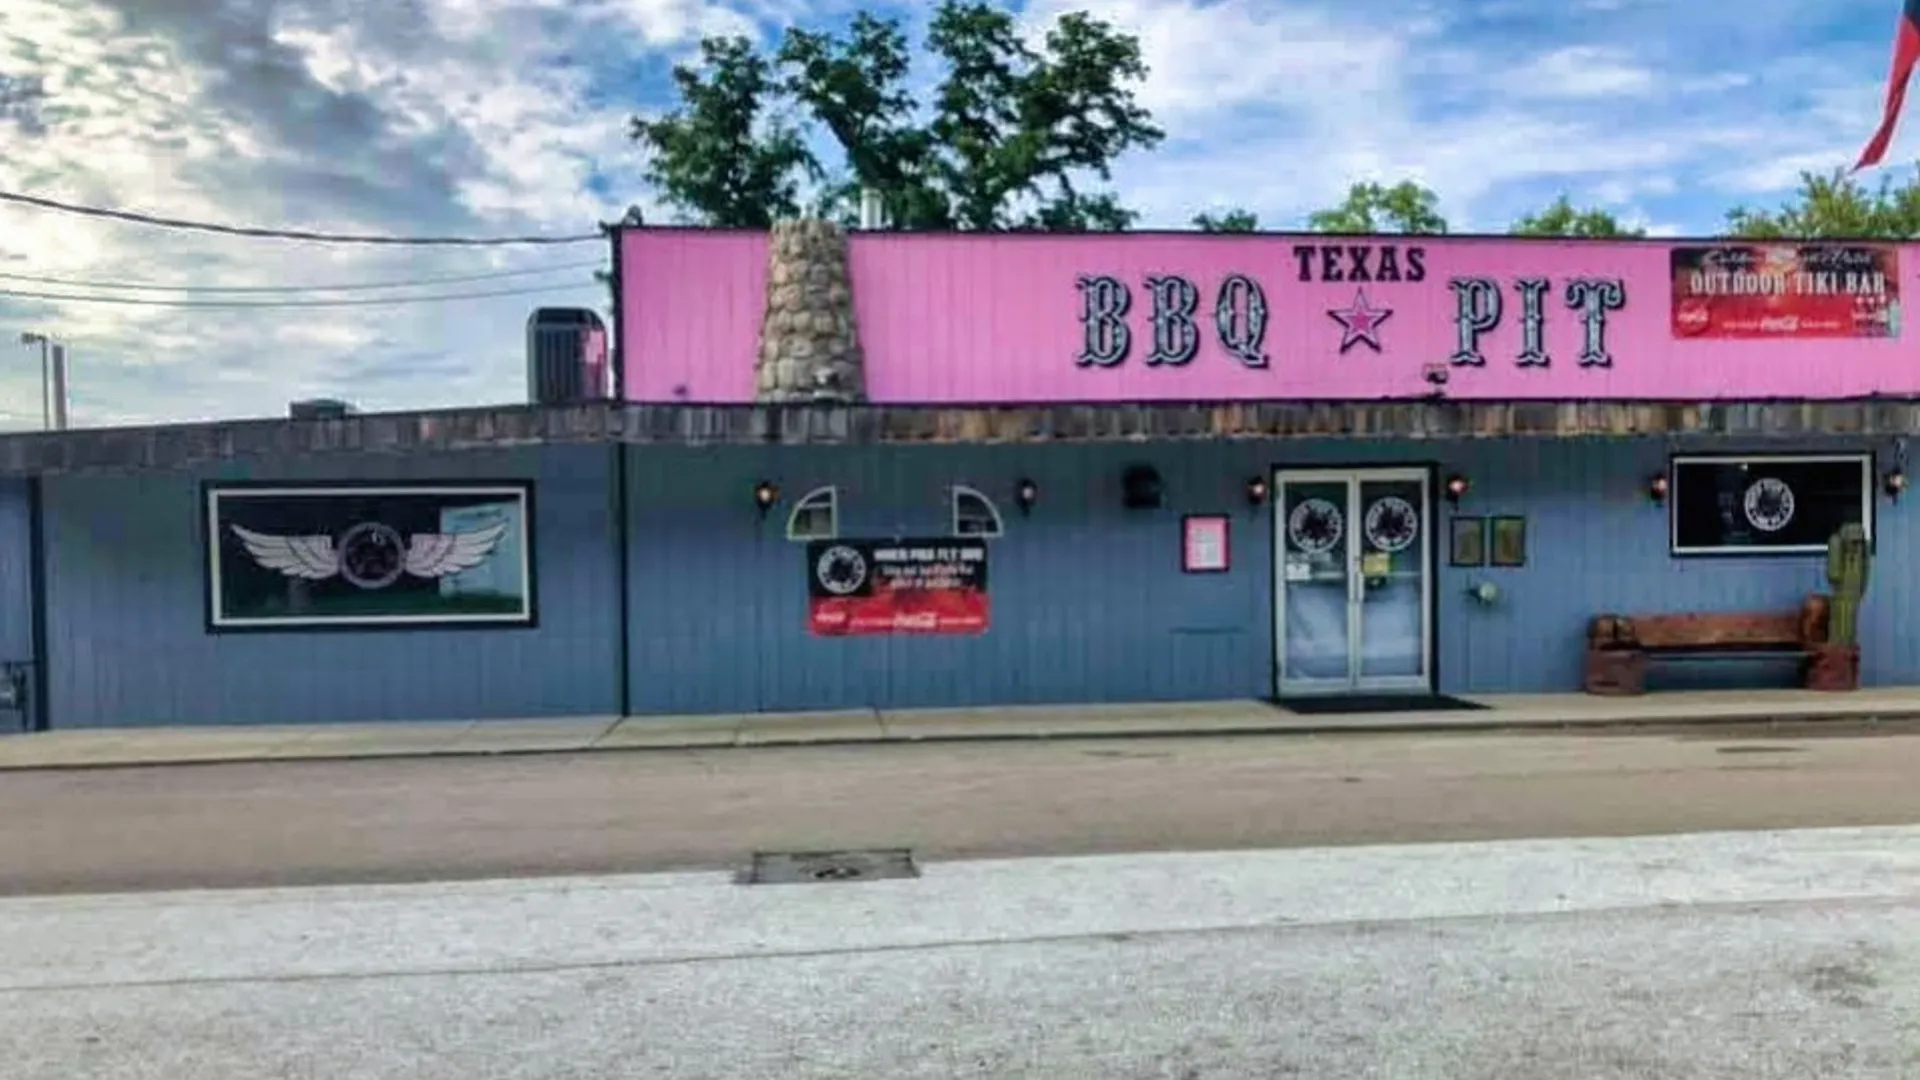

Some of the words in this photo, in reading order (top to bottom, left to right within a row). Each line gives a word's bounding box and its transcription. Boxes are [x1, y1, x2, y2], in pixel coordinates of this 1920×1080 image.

[1293, 245, 1426, 282] TEXAS
[1690, 271, 1785, 295] OUTDOOR
[1794, 271, 1838, 295] TIKI
[1846, 270, 1885, 295] BAR
[1076, 274, 1269, 369] BBQ
[1449, 275, 1626, 368] PIT
